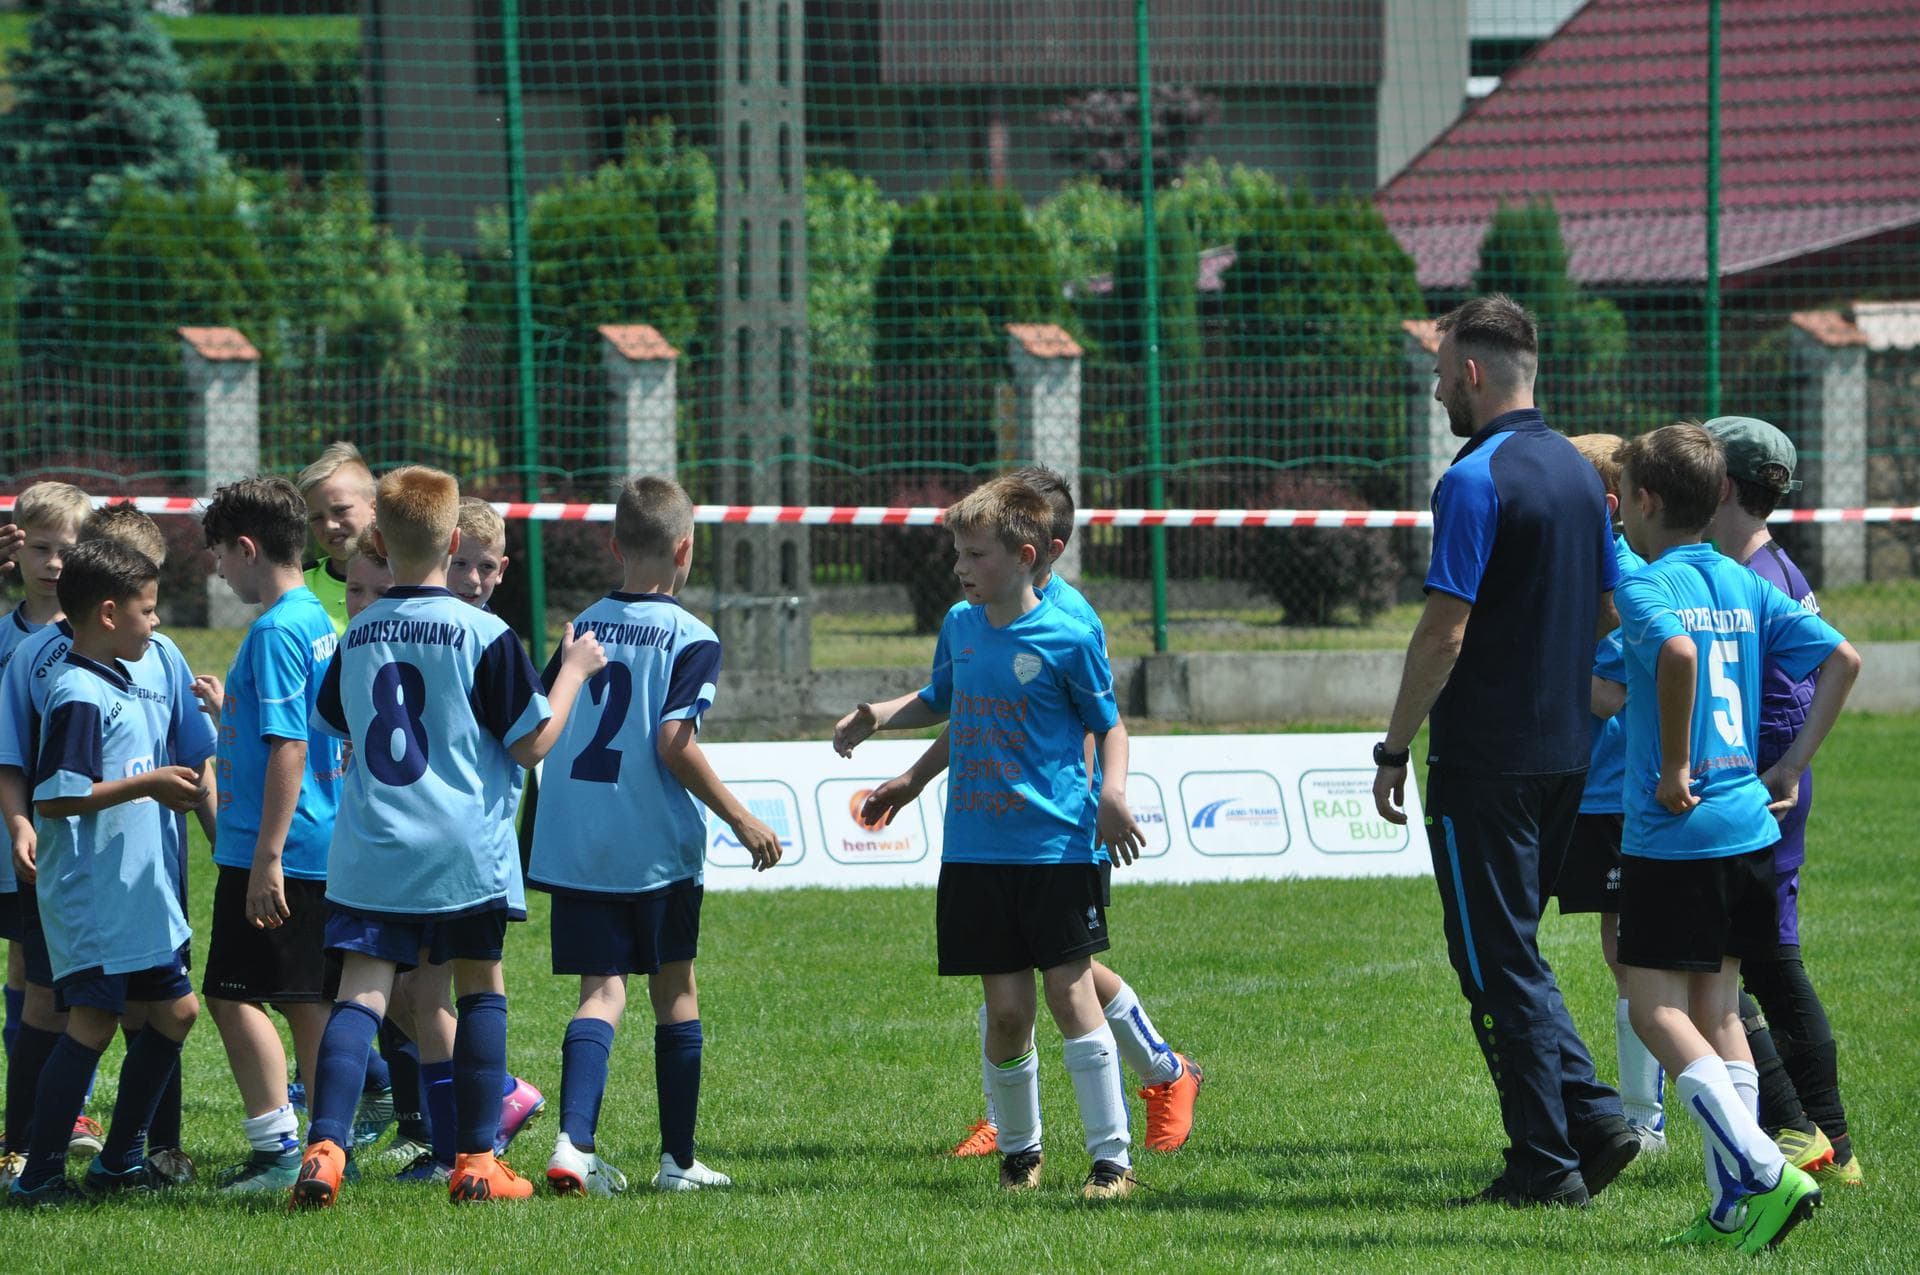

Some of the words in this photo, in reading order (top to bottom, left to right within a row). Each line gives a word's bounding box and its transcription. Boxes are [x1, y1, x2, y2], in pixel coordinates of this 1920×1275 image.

[347, 620, 466, 651] RADZISZOWIANKA
[573, 621, 676, 653] ADZISZOWIANKA
[43, 642, 69, 668] VIGO
[955, 689, 1028, 722] Shared
[1708, 640, 1744, 747] 5
[104, 701, 123, 727] VIGO
[365, 661, 429, 787] 8
[570, 660, 632, 784] 2
[954, 721, 1026, 751] Service
[955, 753, 1021, 781] Centre
[953, 786, 1026, 817] Europe
[1312, 800, 1362, 818] RAD
[842, 837, 911, 851] henwal
[1349, 821, 1398, 840] BUD
